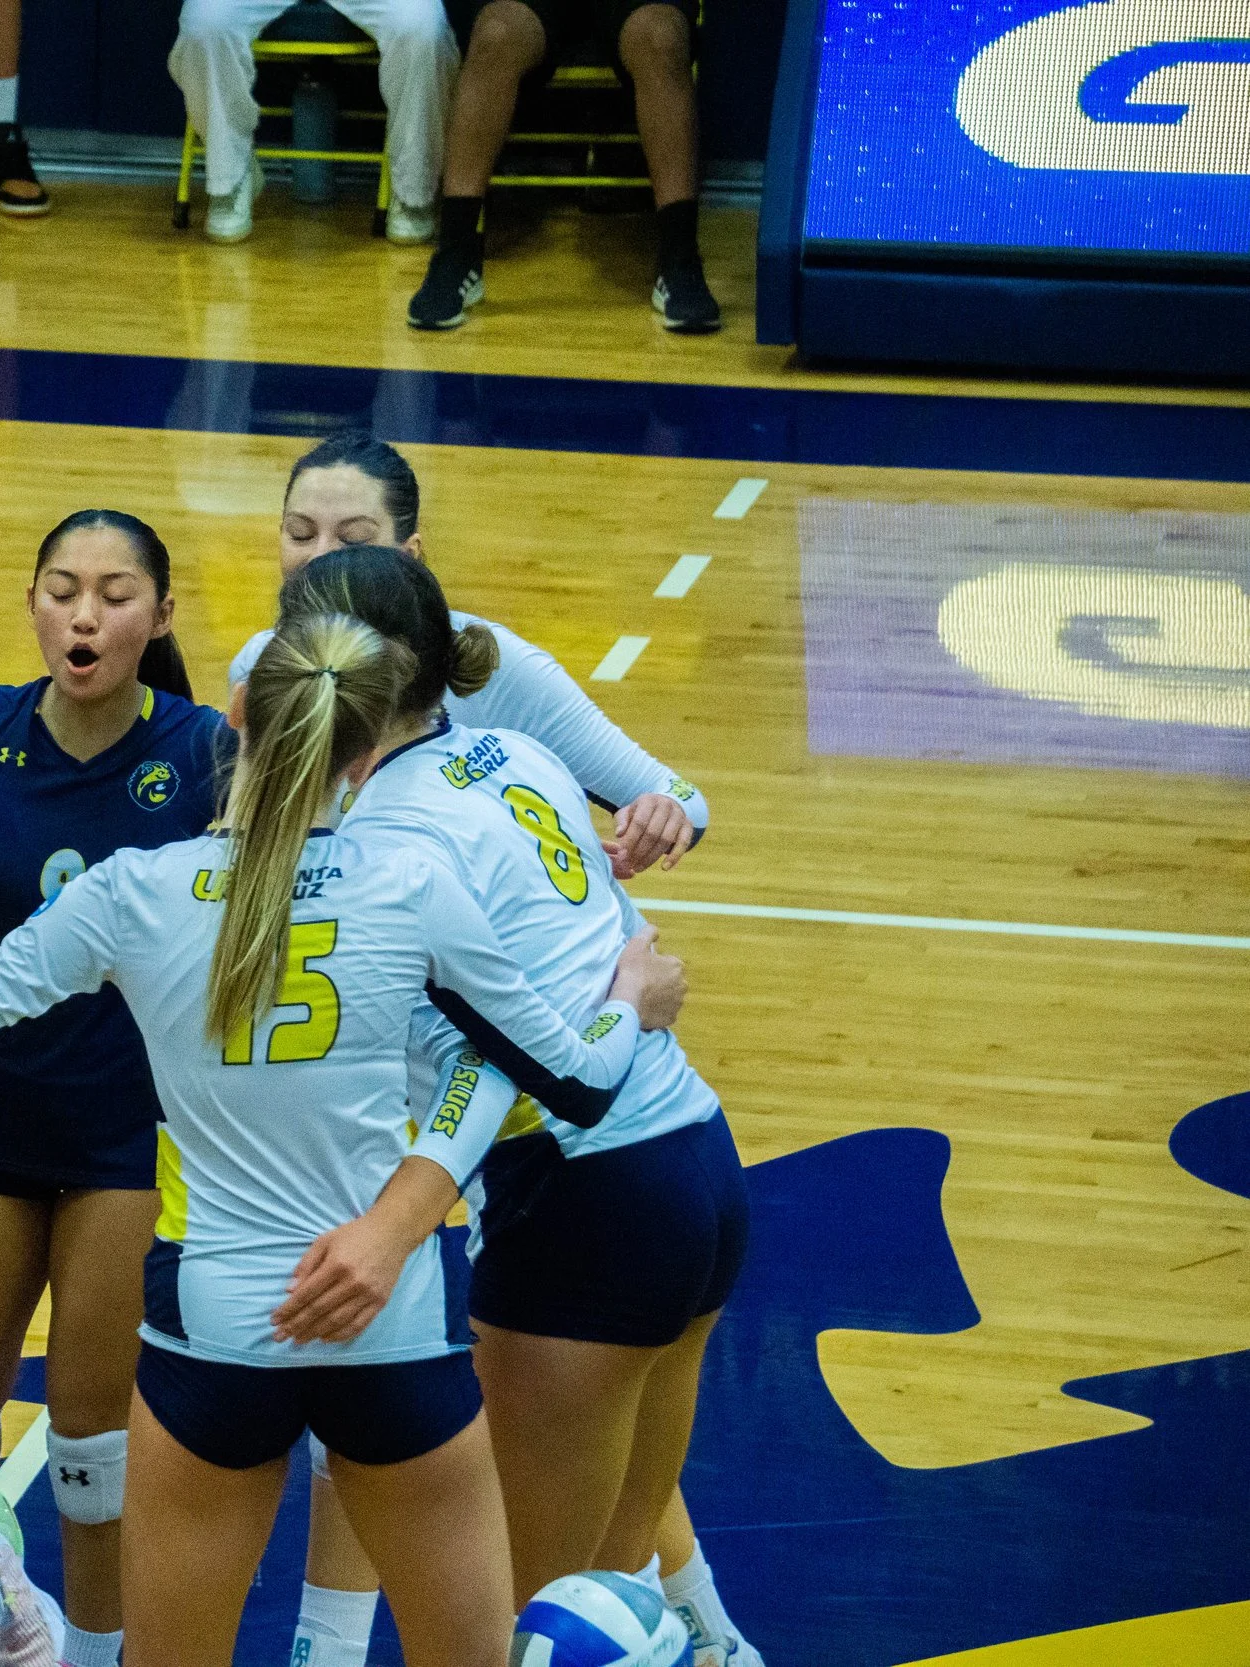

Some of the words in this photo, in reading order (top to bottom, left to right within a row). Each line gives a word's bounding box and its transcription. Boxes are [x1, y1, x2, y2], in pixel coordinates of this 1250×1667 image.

[478, 747, 510, 774] RUZ
[501, 783, 588, 905] 8
[295, 866, 343, 883] NTA
[291, 882, 327, 900] UZ
[430, 1066, 480, 1139] SLUGS
